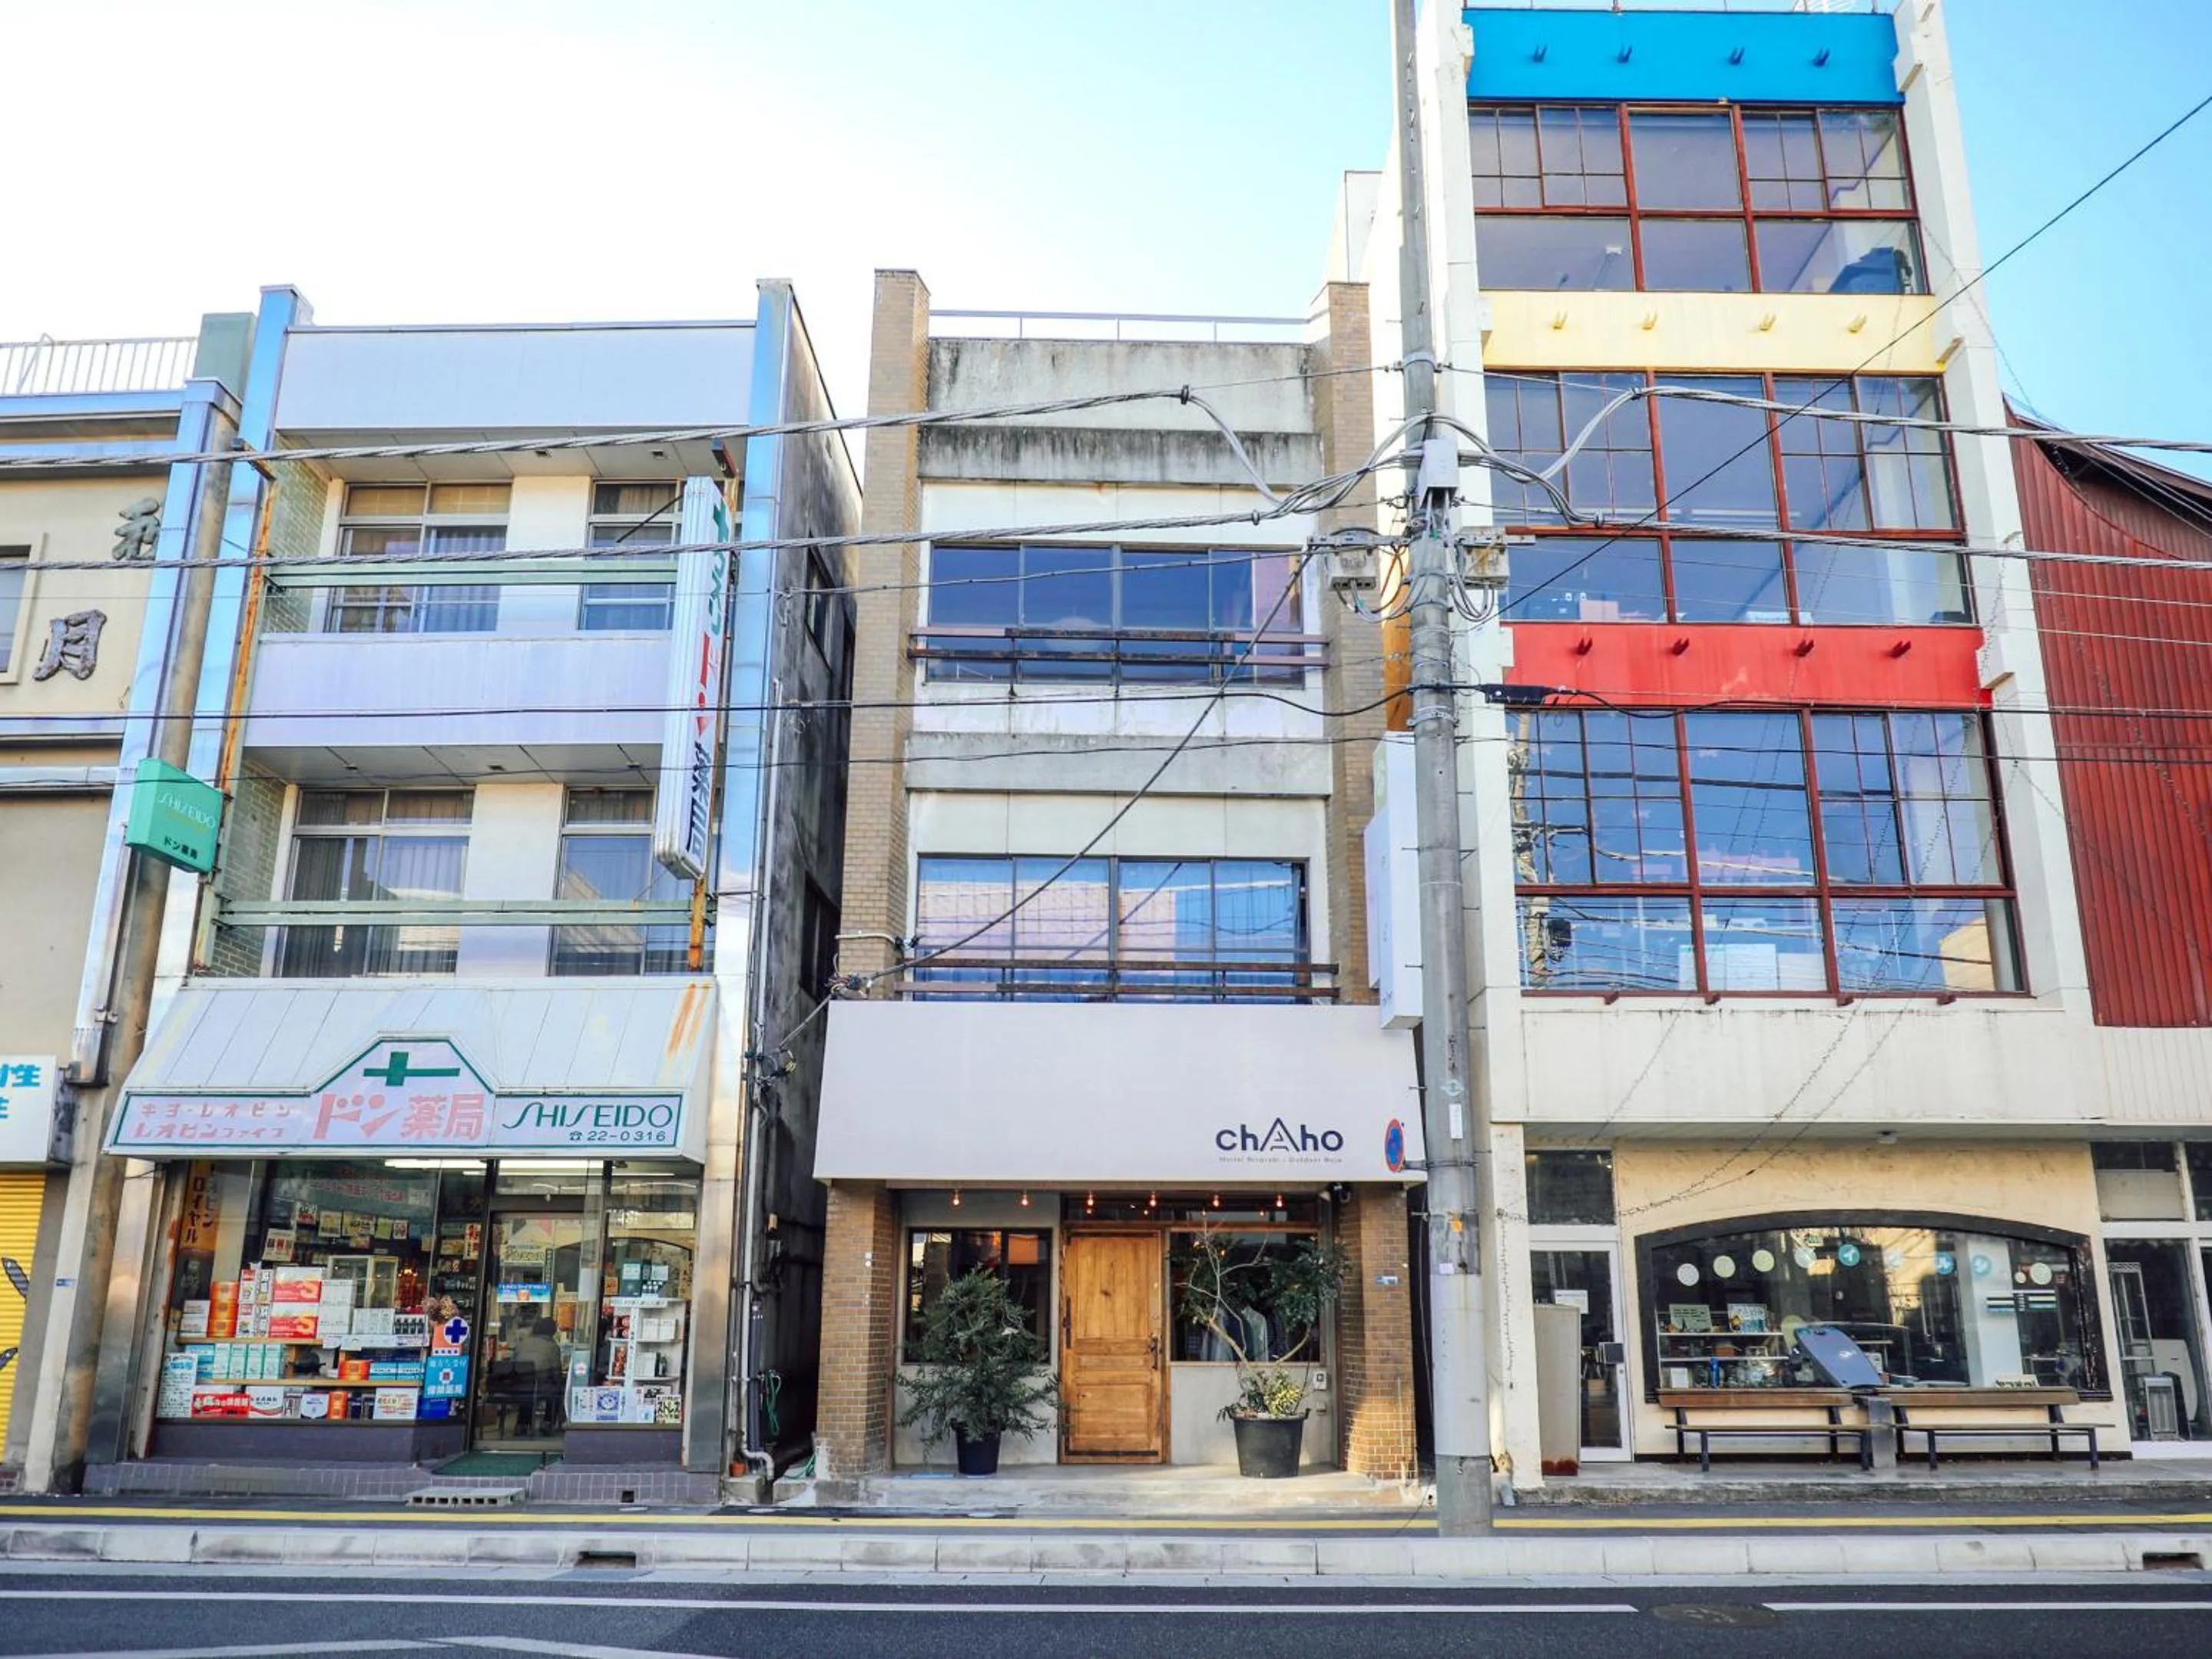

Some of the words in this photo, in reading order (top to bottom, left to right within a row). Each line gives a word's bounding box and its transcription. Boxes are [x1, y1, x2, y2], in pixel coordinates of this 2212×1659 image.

[157, 793, 216, 828] SHISEIDO
[313, 1092, 485, 1141] ドン薬局
[502, 1101, 674, 1129] SHISEIDO
[587, 1131, 667, 1142] 22-0316
